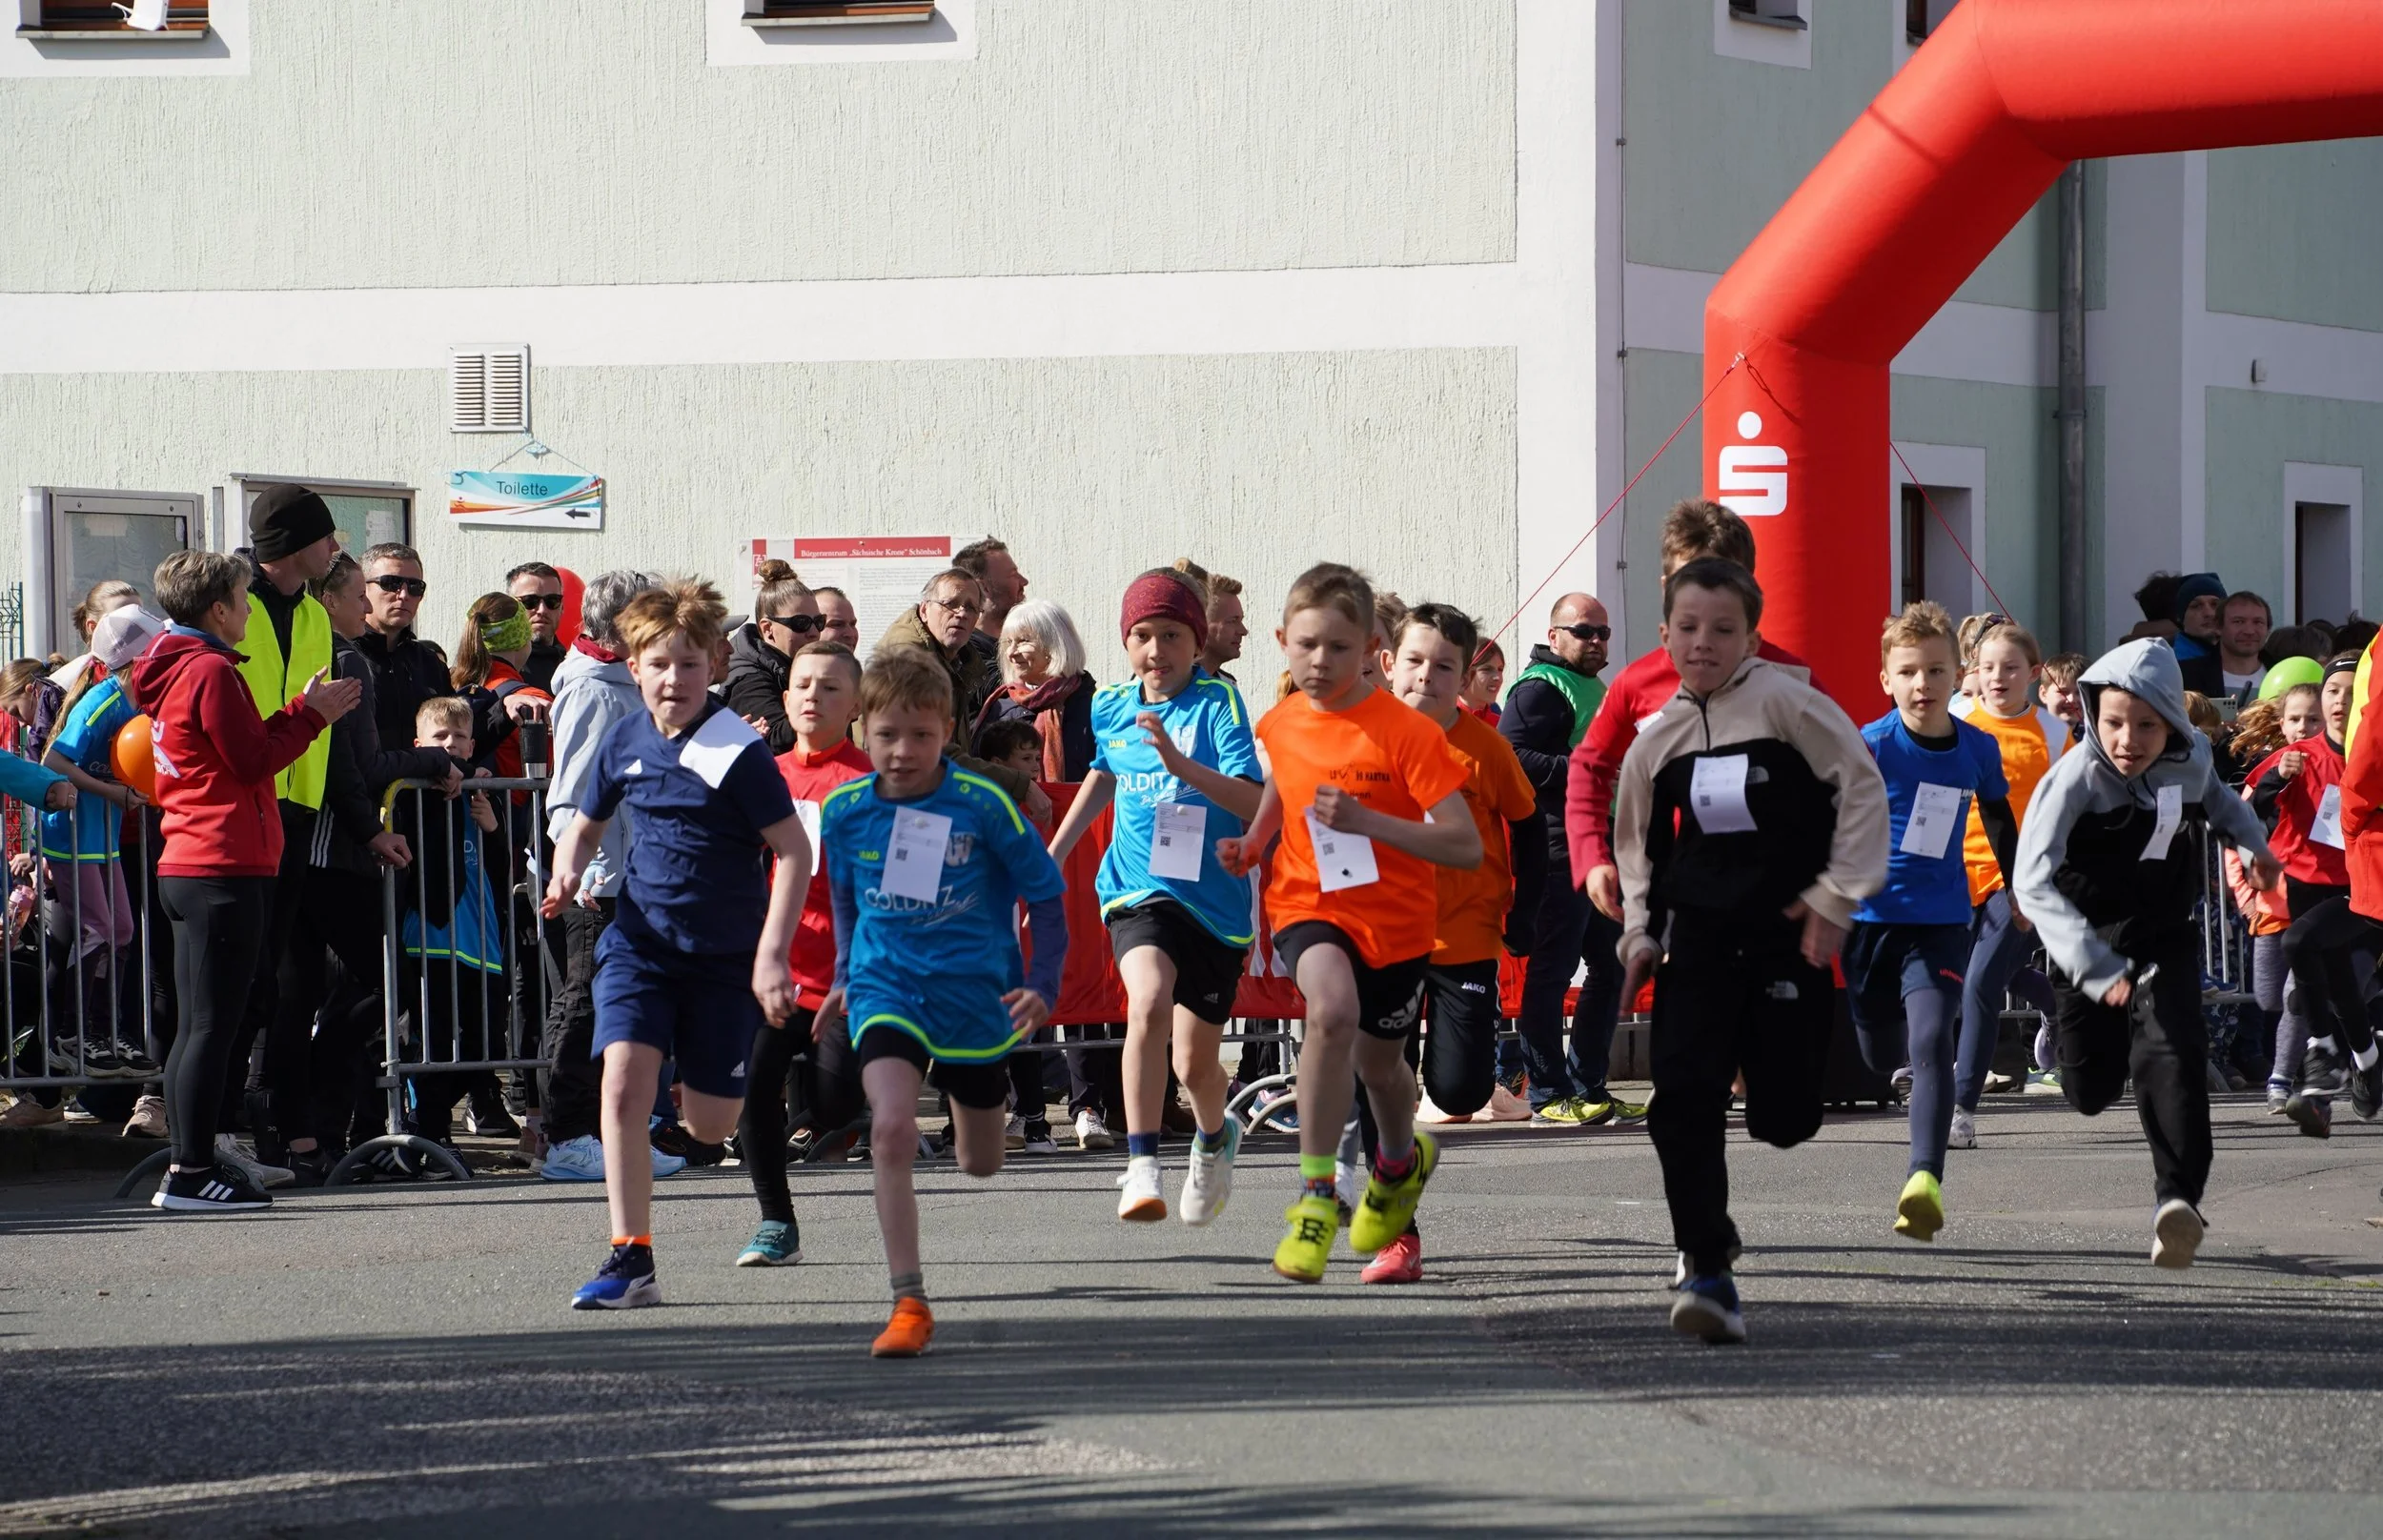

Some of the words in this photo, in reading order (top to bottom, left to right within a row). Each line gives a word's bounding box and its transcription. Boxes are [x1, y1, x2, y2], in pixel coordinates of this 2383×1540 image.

[496, 480, 549, 496] Toilette
[801, 549, 847, 558] Bürgerzentrum
[908, 546, 943, 557] Schönbach
[1461, 982, 1486, 995] JAKO
